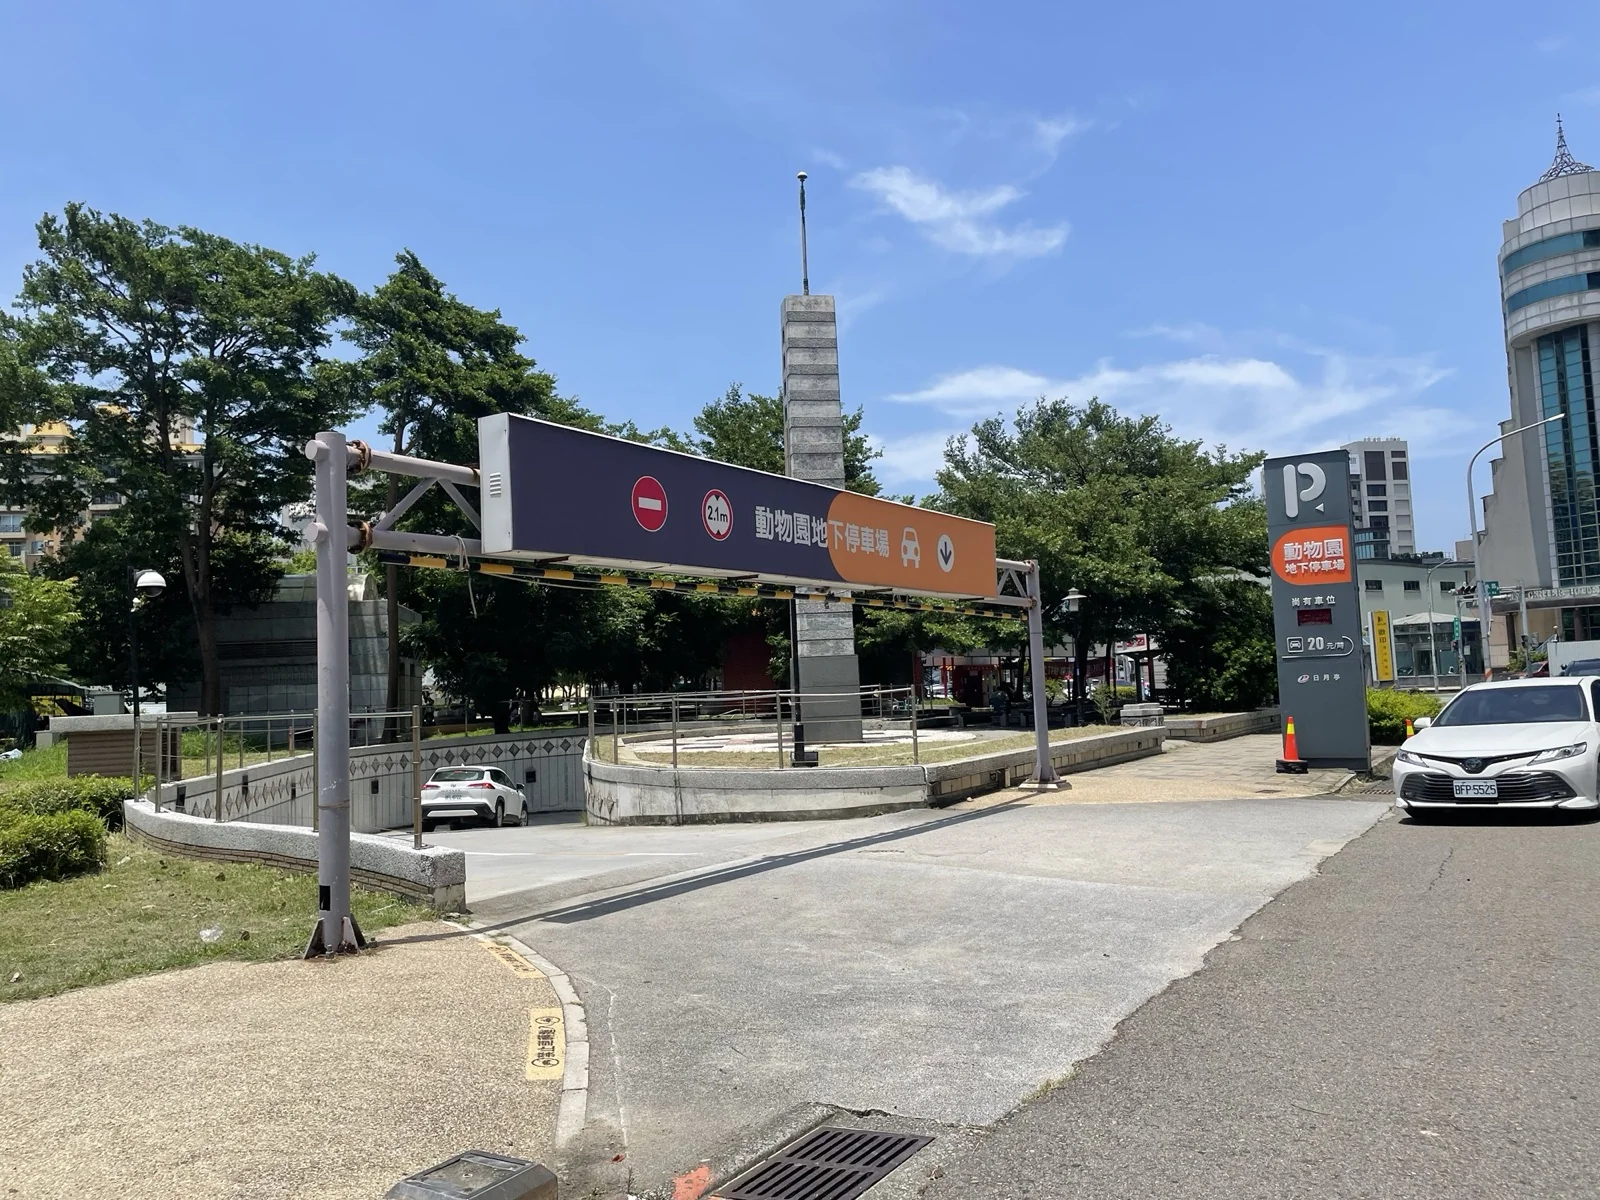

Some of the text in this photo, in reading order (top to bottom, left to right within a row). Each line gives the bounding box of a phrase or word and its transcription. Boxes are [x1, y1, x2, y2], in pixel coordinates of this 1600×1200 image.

[707, 505, 729, 523] 2.1m
[754, 505, 890, 558] 動物園地下停車場
[1283, 538, 1344, 561] 動物園
[1285, 558, 1345, 574] 地下停車場
[1291, 595, 1336, 607] 尚有車位
[1307, 636, 1345, 651] 20 元/時
[1312, 673, 1341, 682] 日月亭
